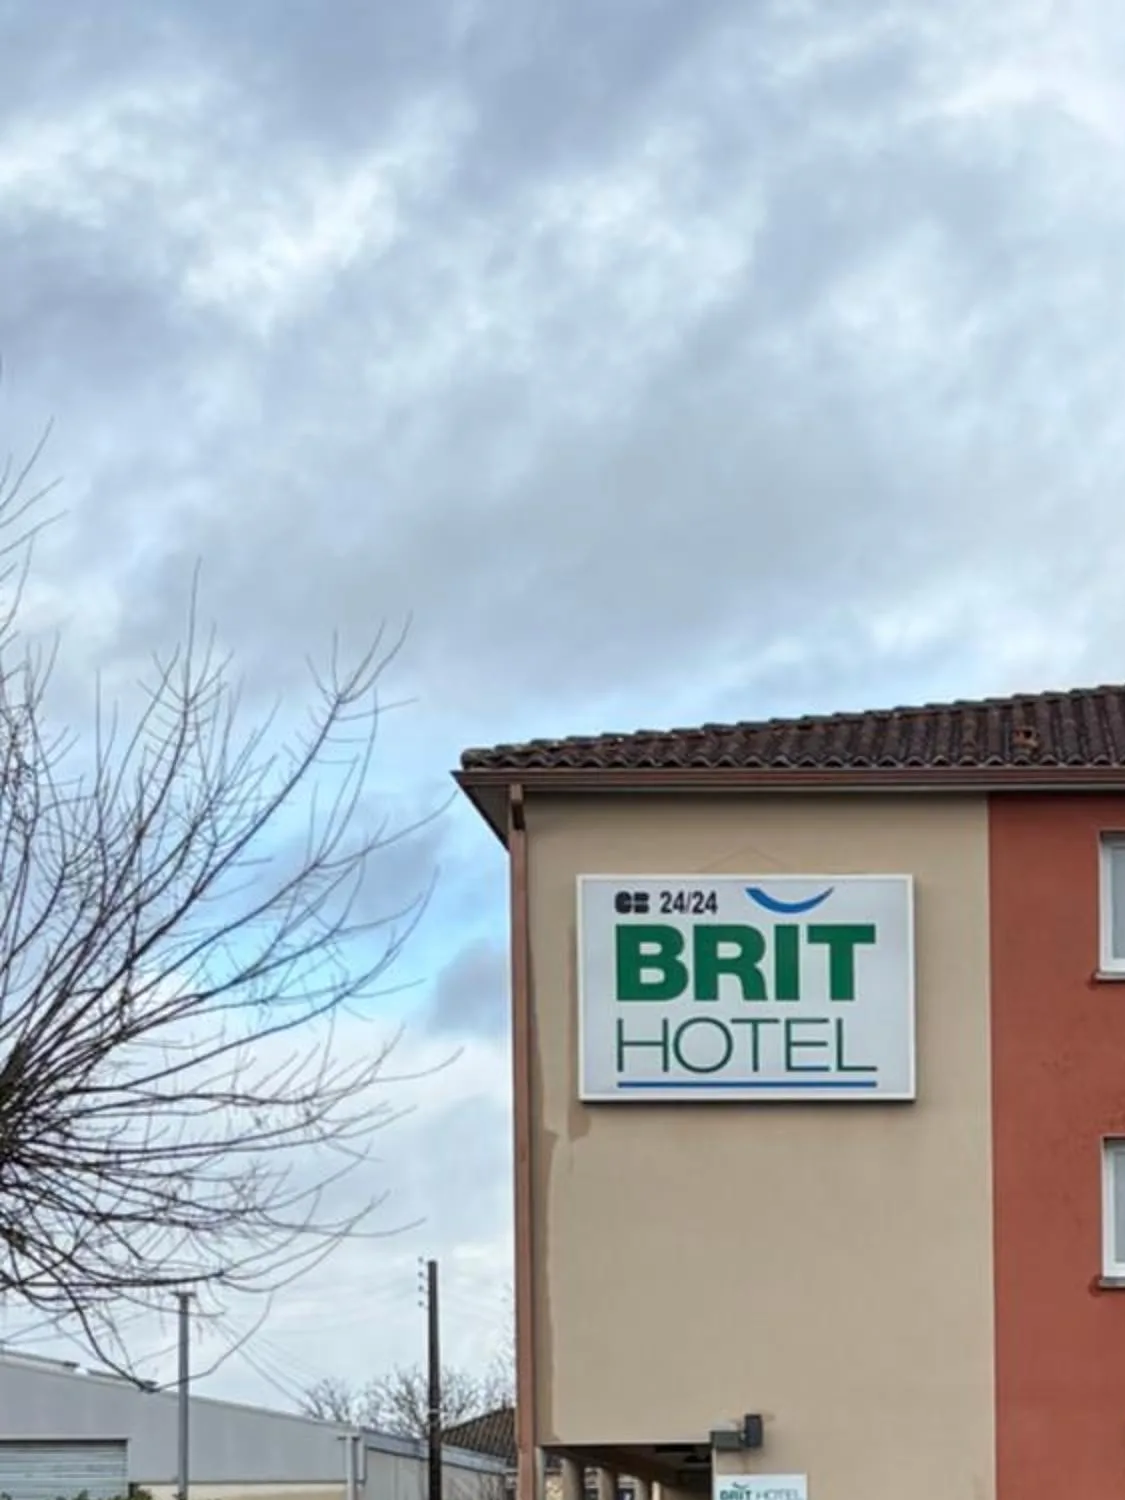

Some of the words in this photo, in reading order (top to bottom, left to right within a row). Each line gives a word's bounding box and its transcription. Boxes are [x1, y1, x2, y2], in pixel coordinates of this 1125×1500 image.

[660, 890, 718, 914] 24/24
[615, 923, 876, 1001] BRIT
[616, 1016, 878, 1074] HOTEL
